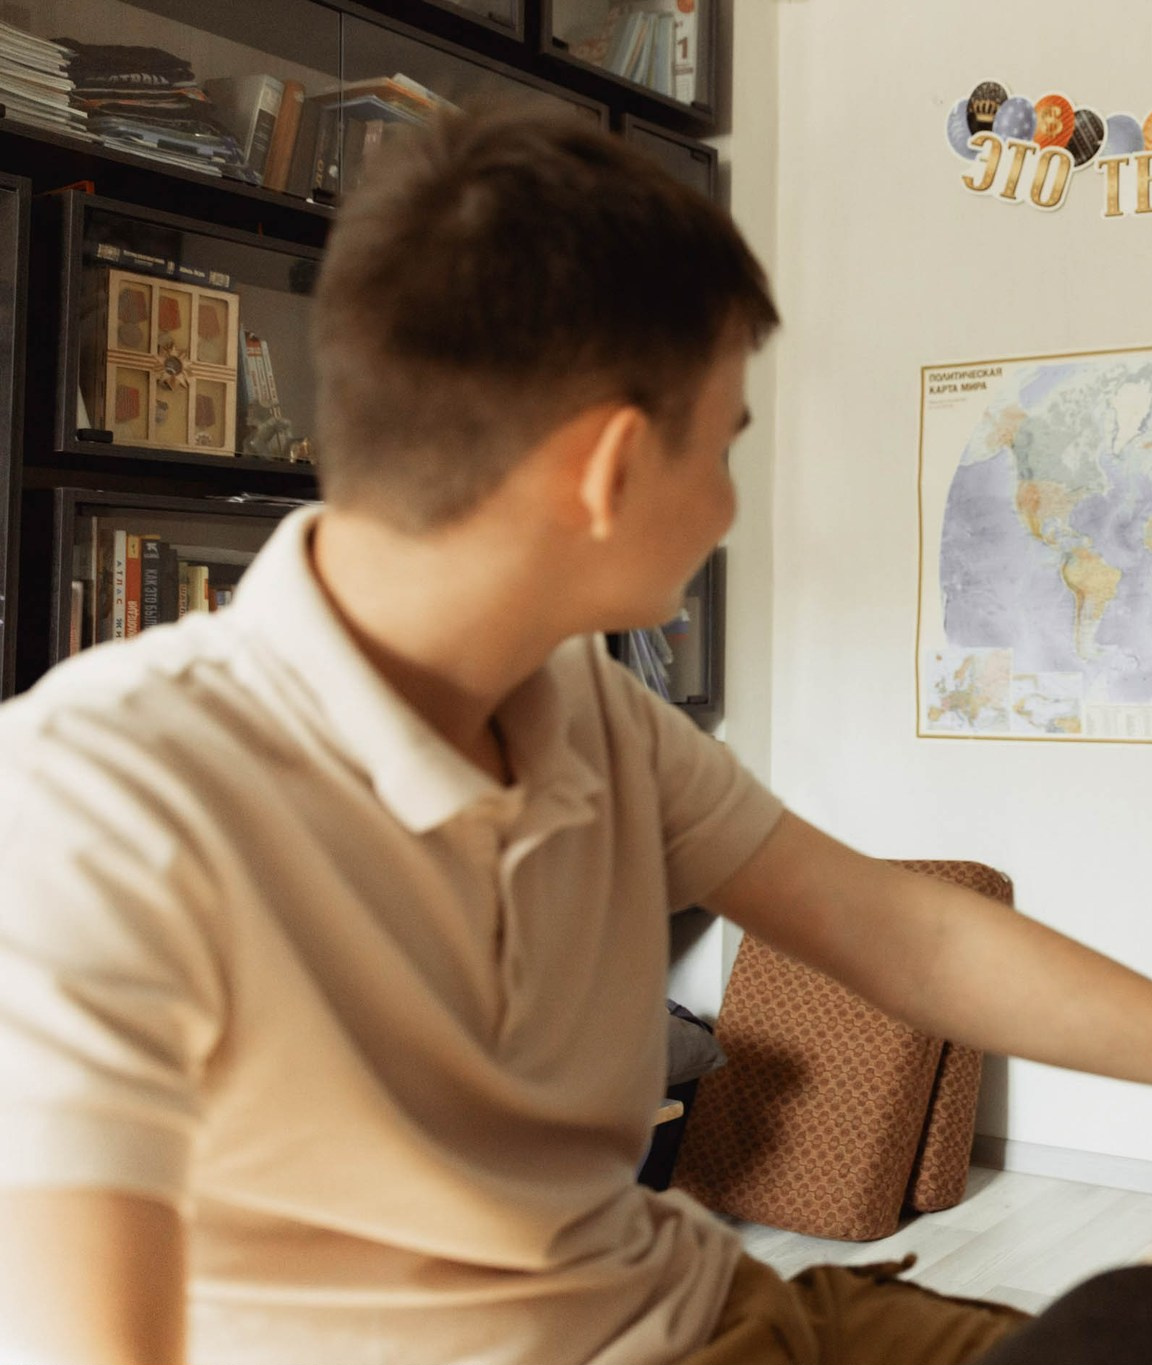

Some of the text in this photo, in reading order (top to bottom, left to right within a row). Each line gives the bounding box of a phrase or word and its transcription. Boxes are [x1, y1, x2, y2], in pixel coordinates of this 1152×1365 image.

[961, 134, 1074, 209] ЭТО
[929, 367, 1003, 382] ПОЛИТИЧЕСКАЯ
[929, 381, 987, 395] КАРТА МИРА
[145, 569, 158, 586] КАК
[145, 604, 158, 628] БЫЛ
[115, 617, 123, 639] ЖИ
